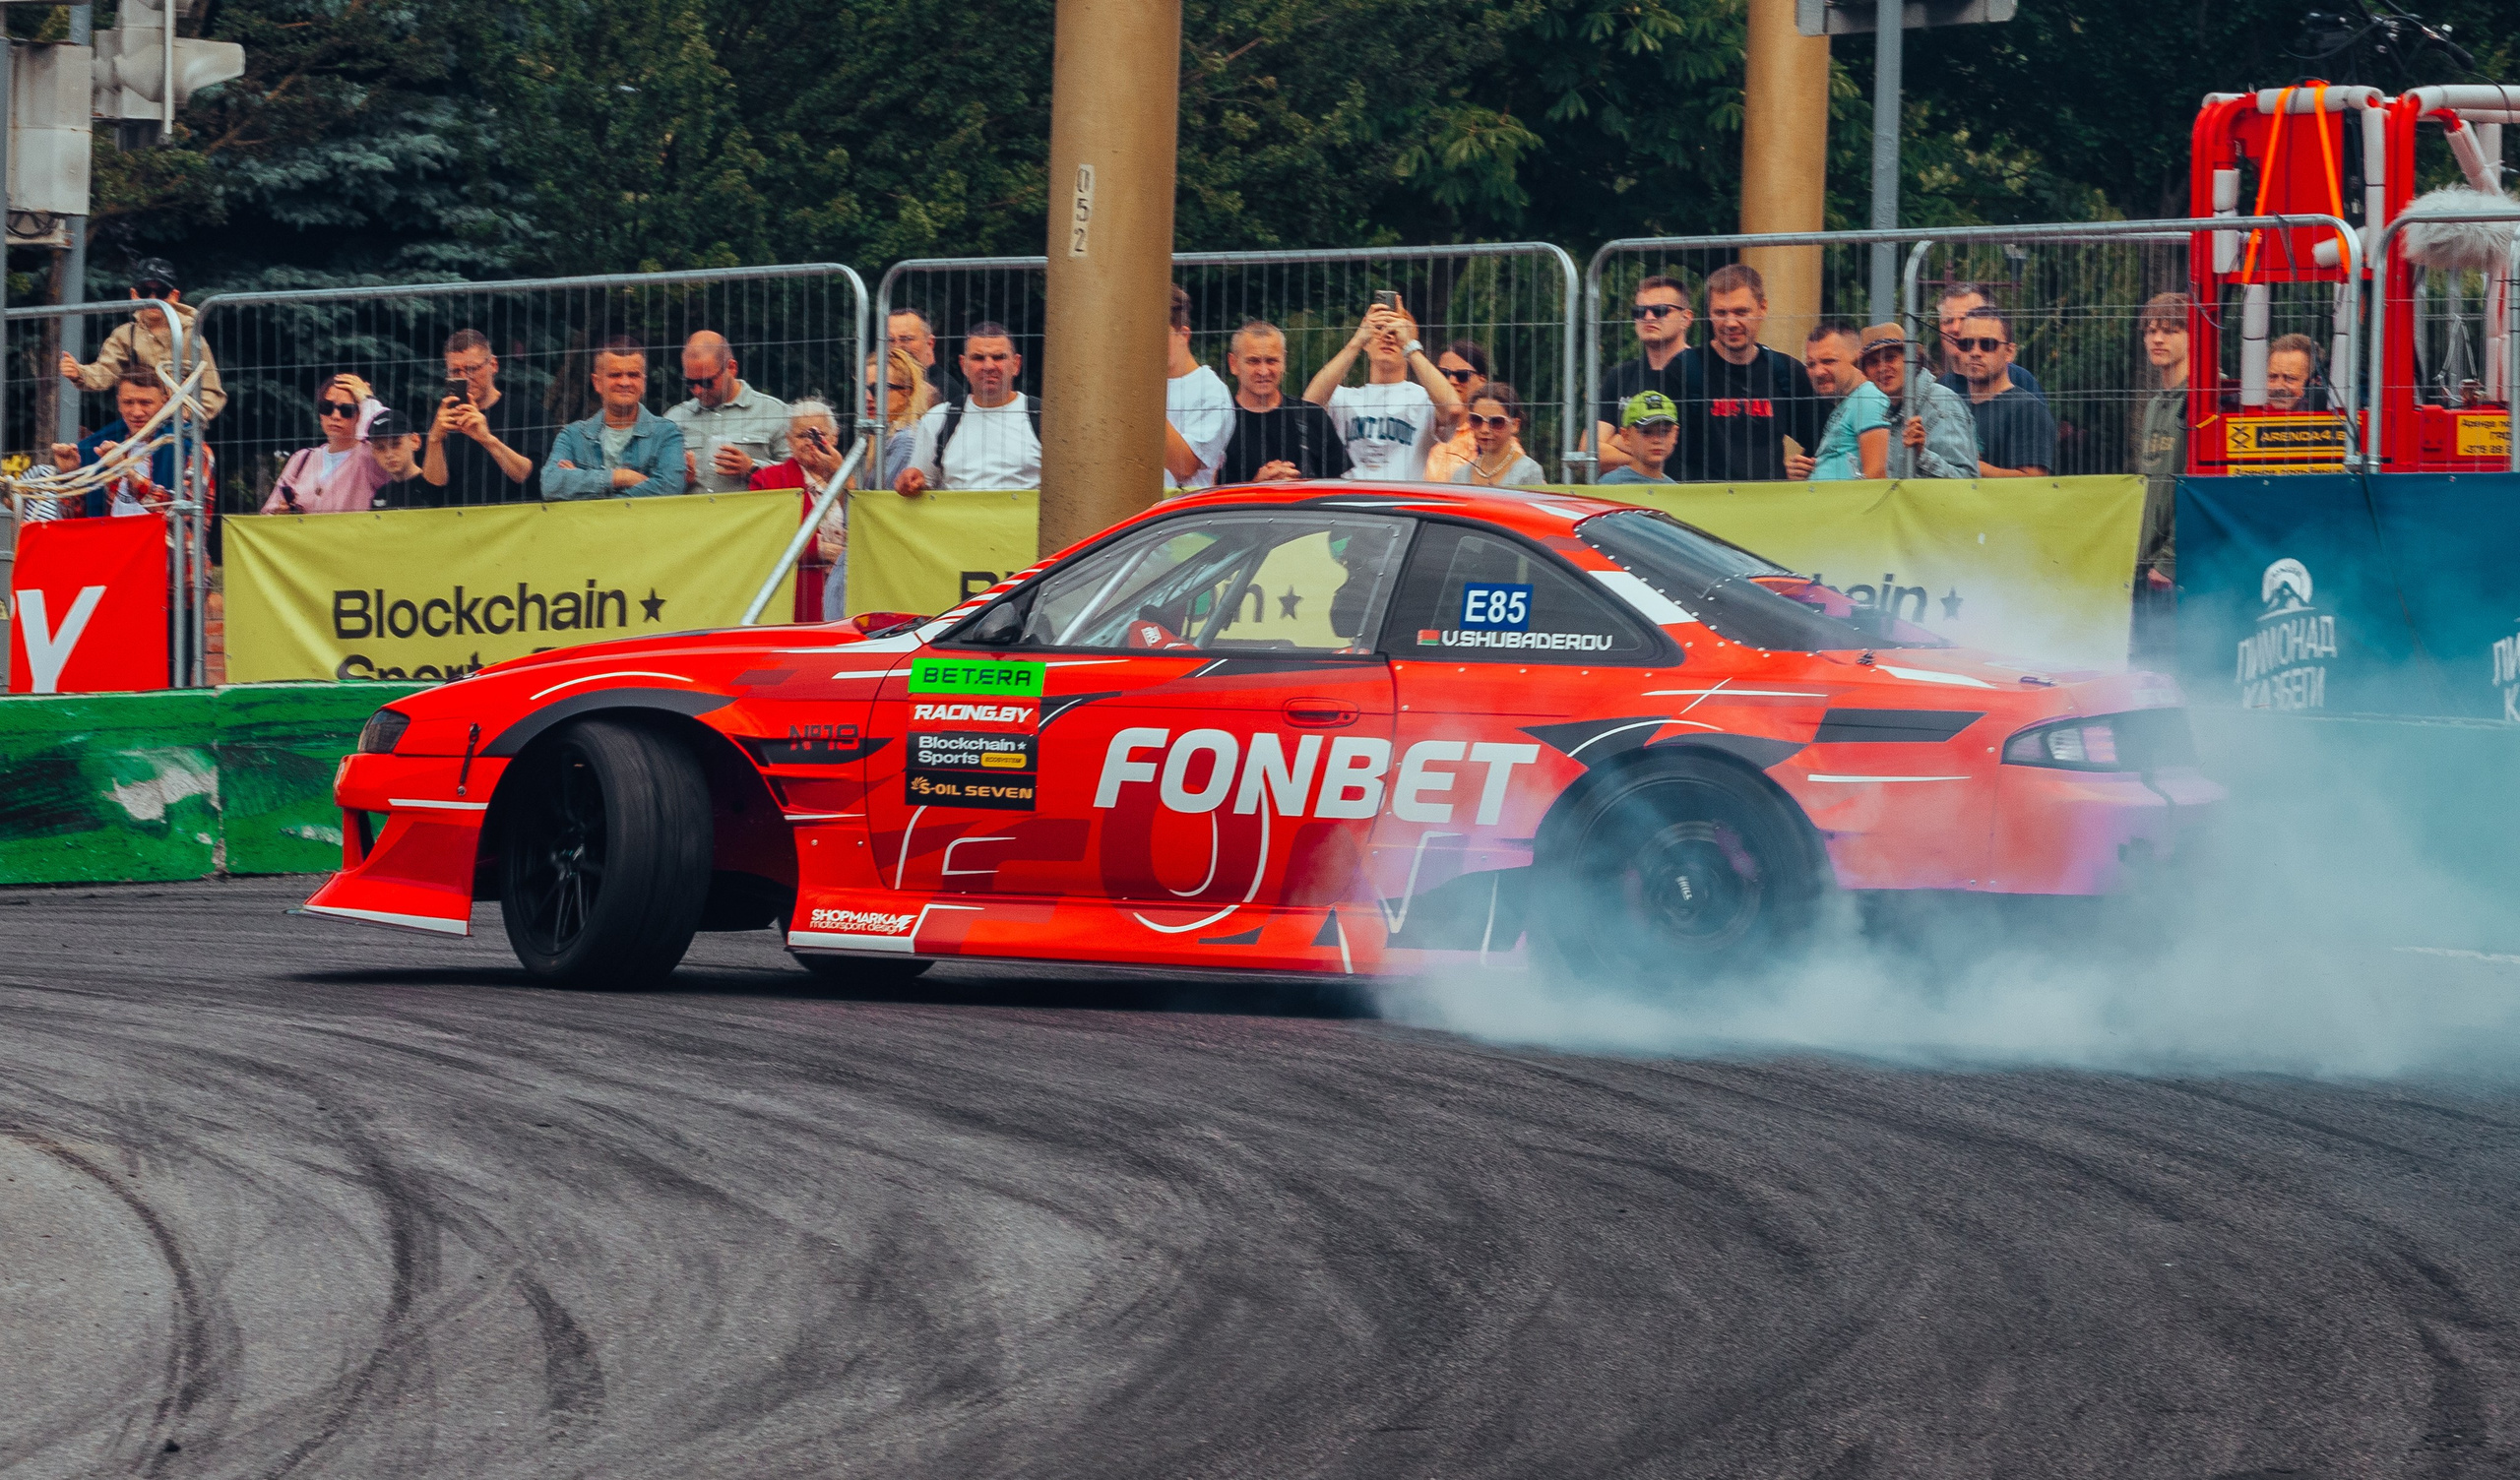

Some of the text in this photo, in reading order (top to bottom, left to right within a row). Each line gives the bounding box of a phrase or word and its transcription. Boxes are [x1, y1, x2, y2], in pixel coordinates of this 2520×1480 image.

[1073, 168, 1090, 252] 052
[2260, 429, 2346, 442] ARENDA4.B
[333, 579, 627, 640] Blockchain
[1465, 589, 1527, 624] E85
[12, 585, 107, 693] Y
[1441, 630, 1612, 650] V.SHUBADEROV
[922, 667, 1031, 687] BETERA
[914, 704, 1034, 723] RACING.BY
[918, 736, 1015, 752] Blockchain
[917, 750, 979, 766] Sports
[1093, 726, 1541, 827] FONBET
[965, 785, 1033, 799] SEVEN
